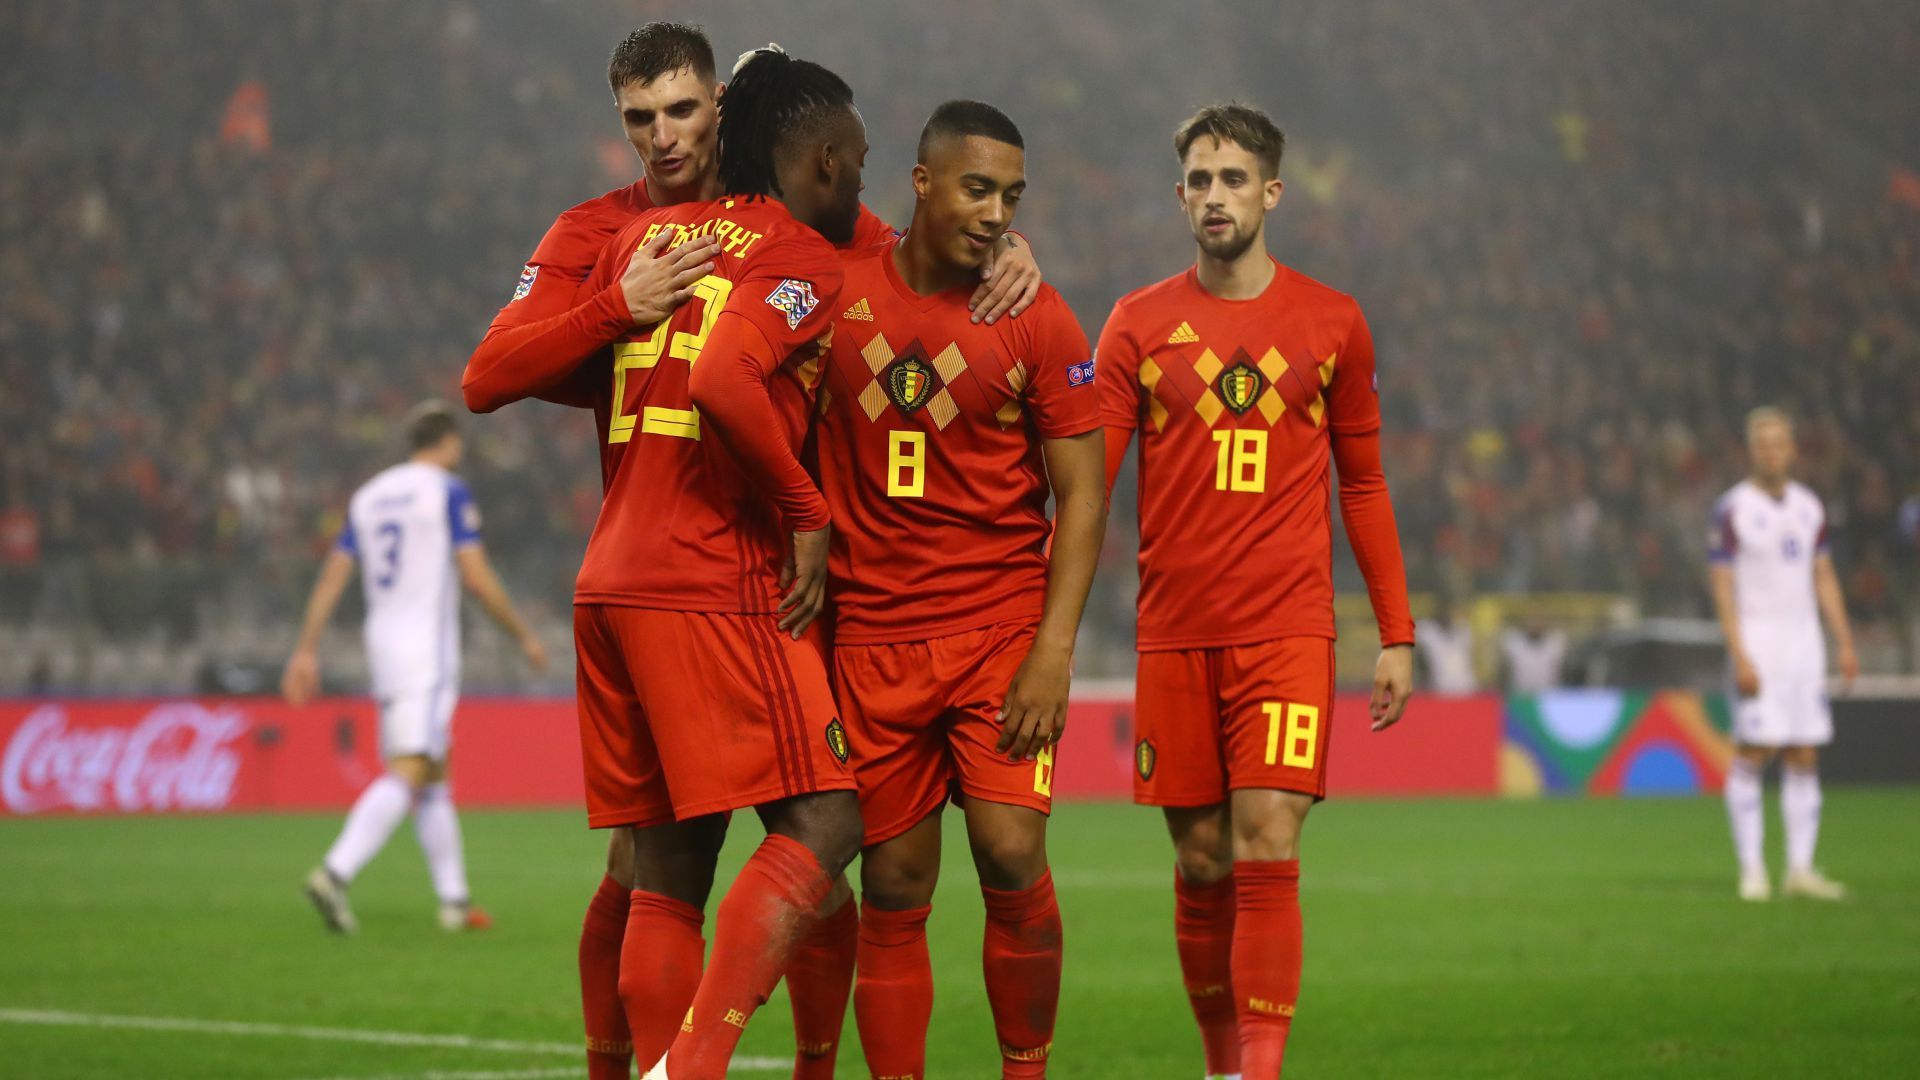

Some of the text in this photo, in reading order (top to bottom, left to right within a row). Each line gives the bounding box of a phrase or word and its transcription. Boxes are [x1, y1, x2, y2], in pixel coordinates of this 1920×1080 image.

[843, 311, 874, 322] adidas
[887, 429, 926, 498] 8
[1212, 429, 1269, 493] 18
[376, 522, 401, 589] 3
[1262, 702, 1319, 769] 18
